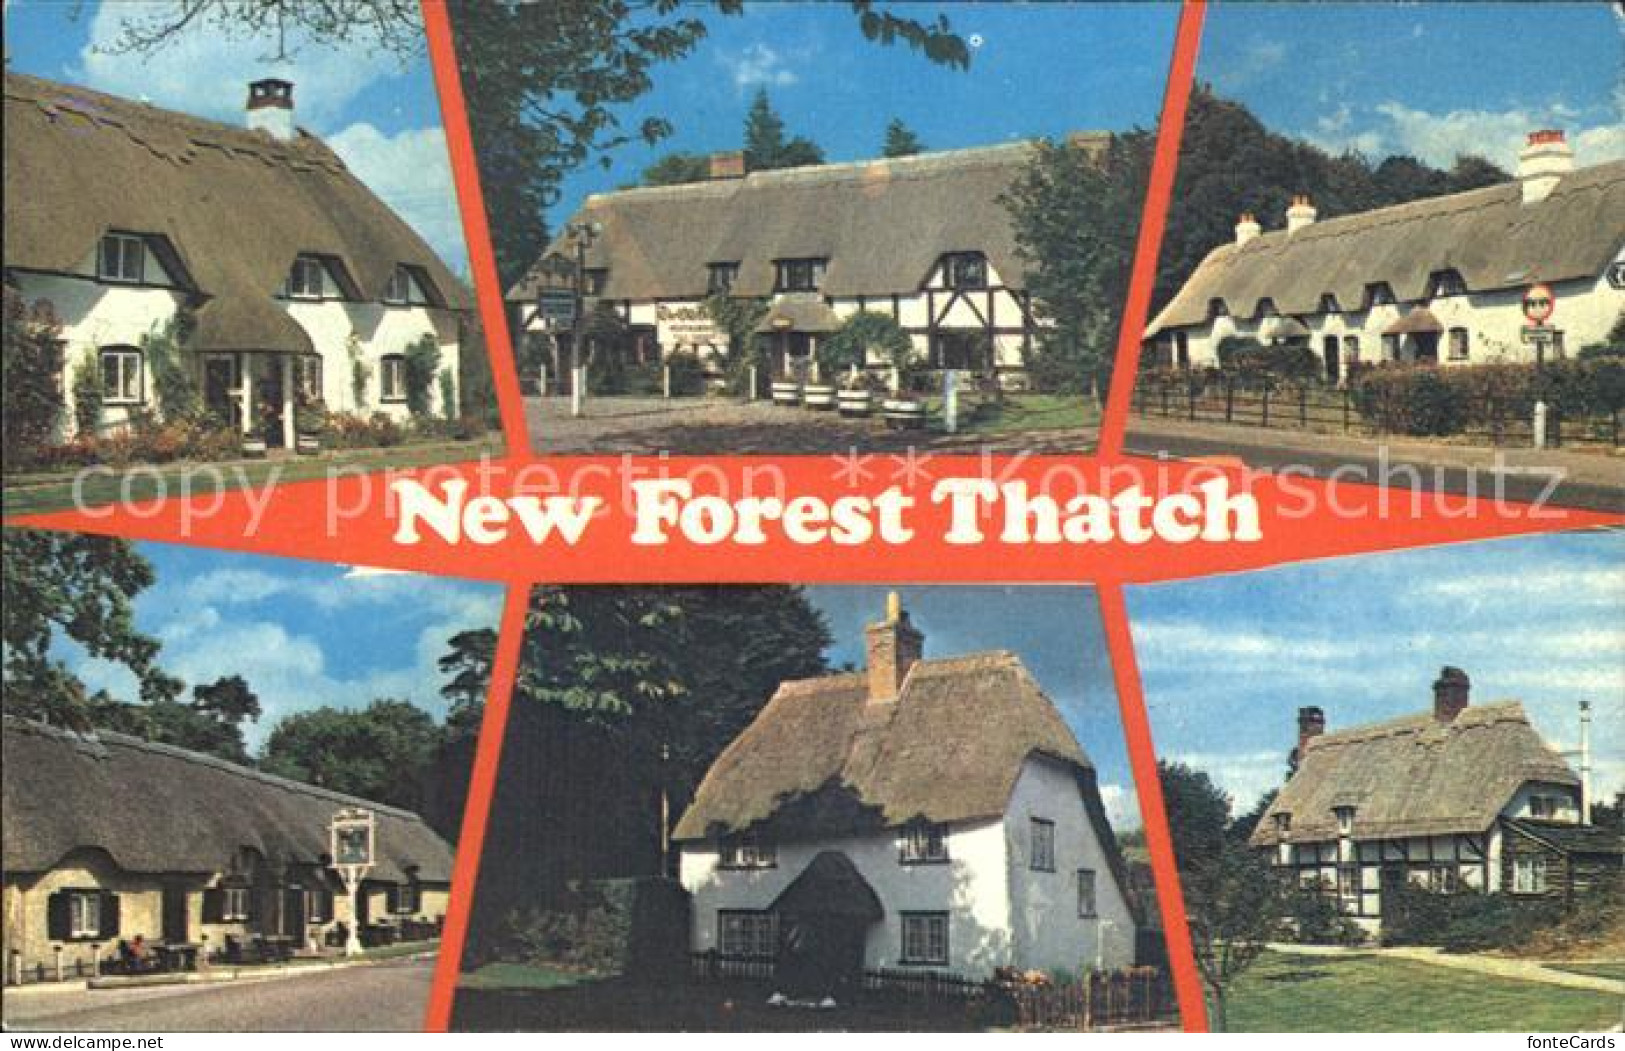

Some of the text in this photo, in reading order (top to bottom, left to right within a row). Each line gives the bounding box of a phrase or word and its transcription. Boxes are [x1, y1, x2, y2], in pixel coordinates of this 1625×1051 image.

[391, 476, 1262, 544] New Forest Thatch
